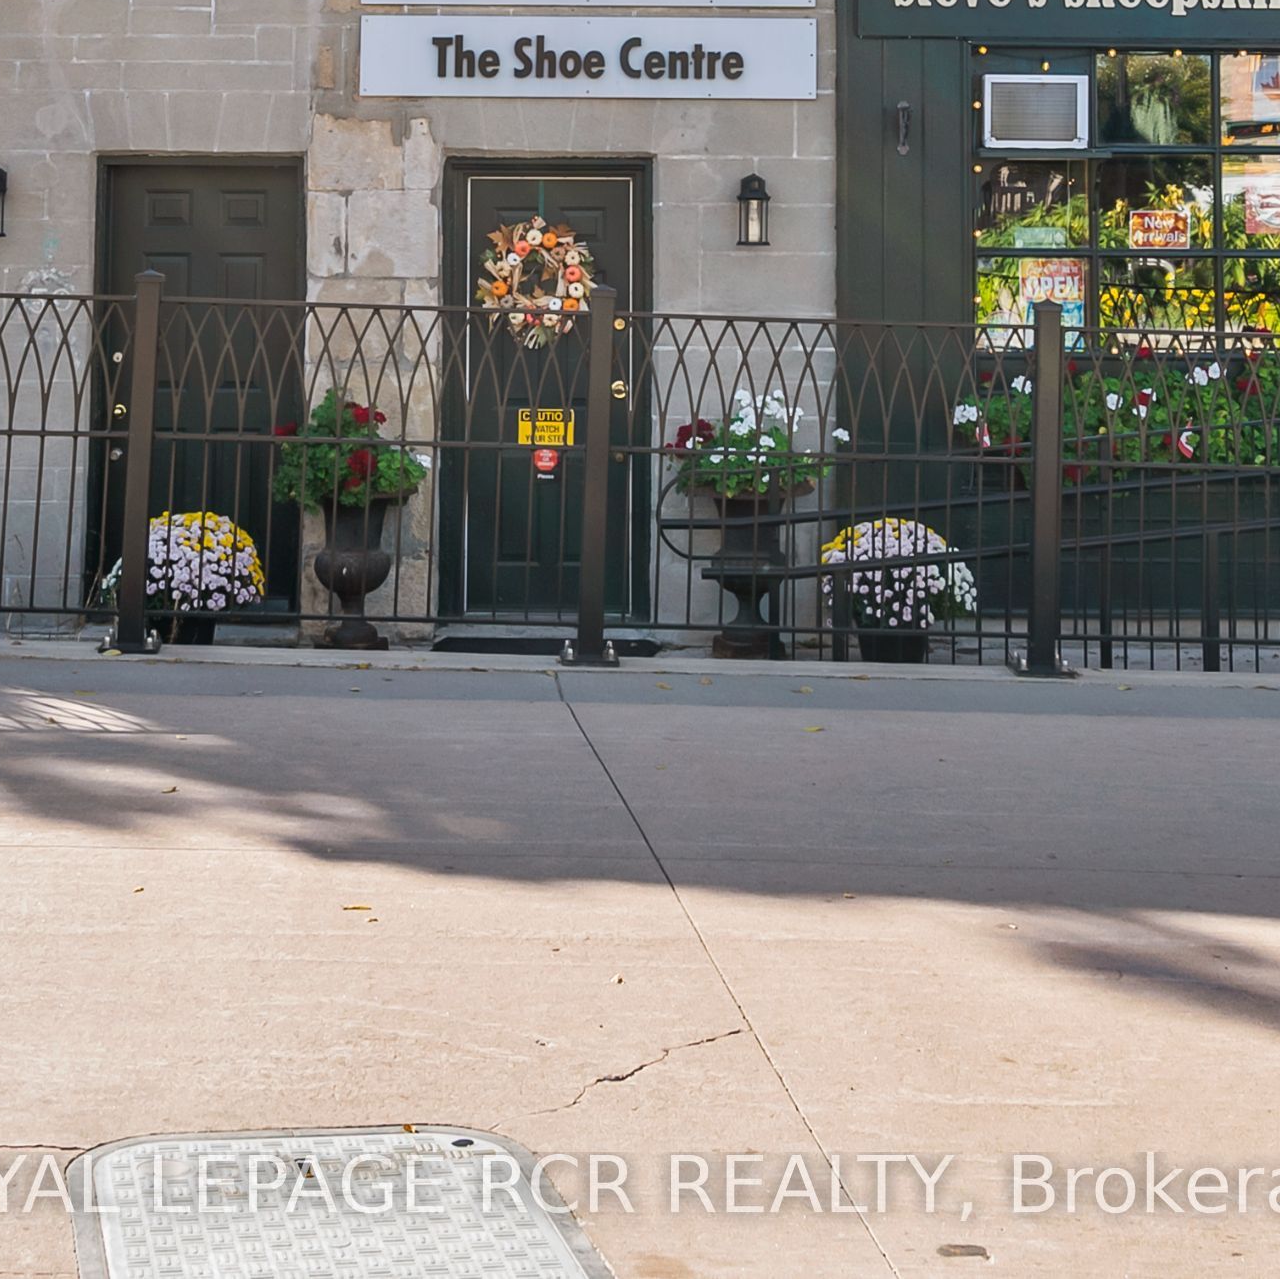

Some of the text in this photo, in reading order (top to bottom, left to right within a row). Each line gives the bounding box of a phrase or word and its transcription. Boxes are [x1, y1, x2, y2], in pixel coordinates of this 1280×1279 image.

[432, 34, 745, 80] The Shoe Centre
[1144, 215, 1176, 229] New
[1133, 230, 1187, 245] Arrivals
[1025, 275, 1080, 299] OPEN
[522, 411, 569, 421] CUTIO
[525, 434, 547, 443] YUR
